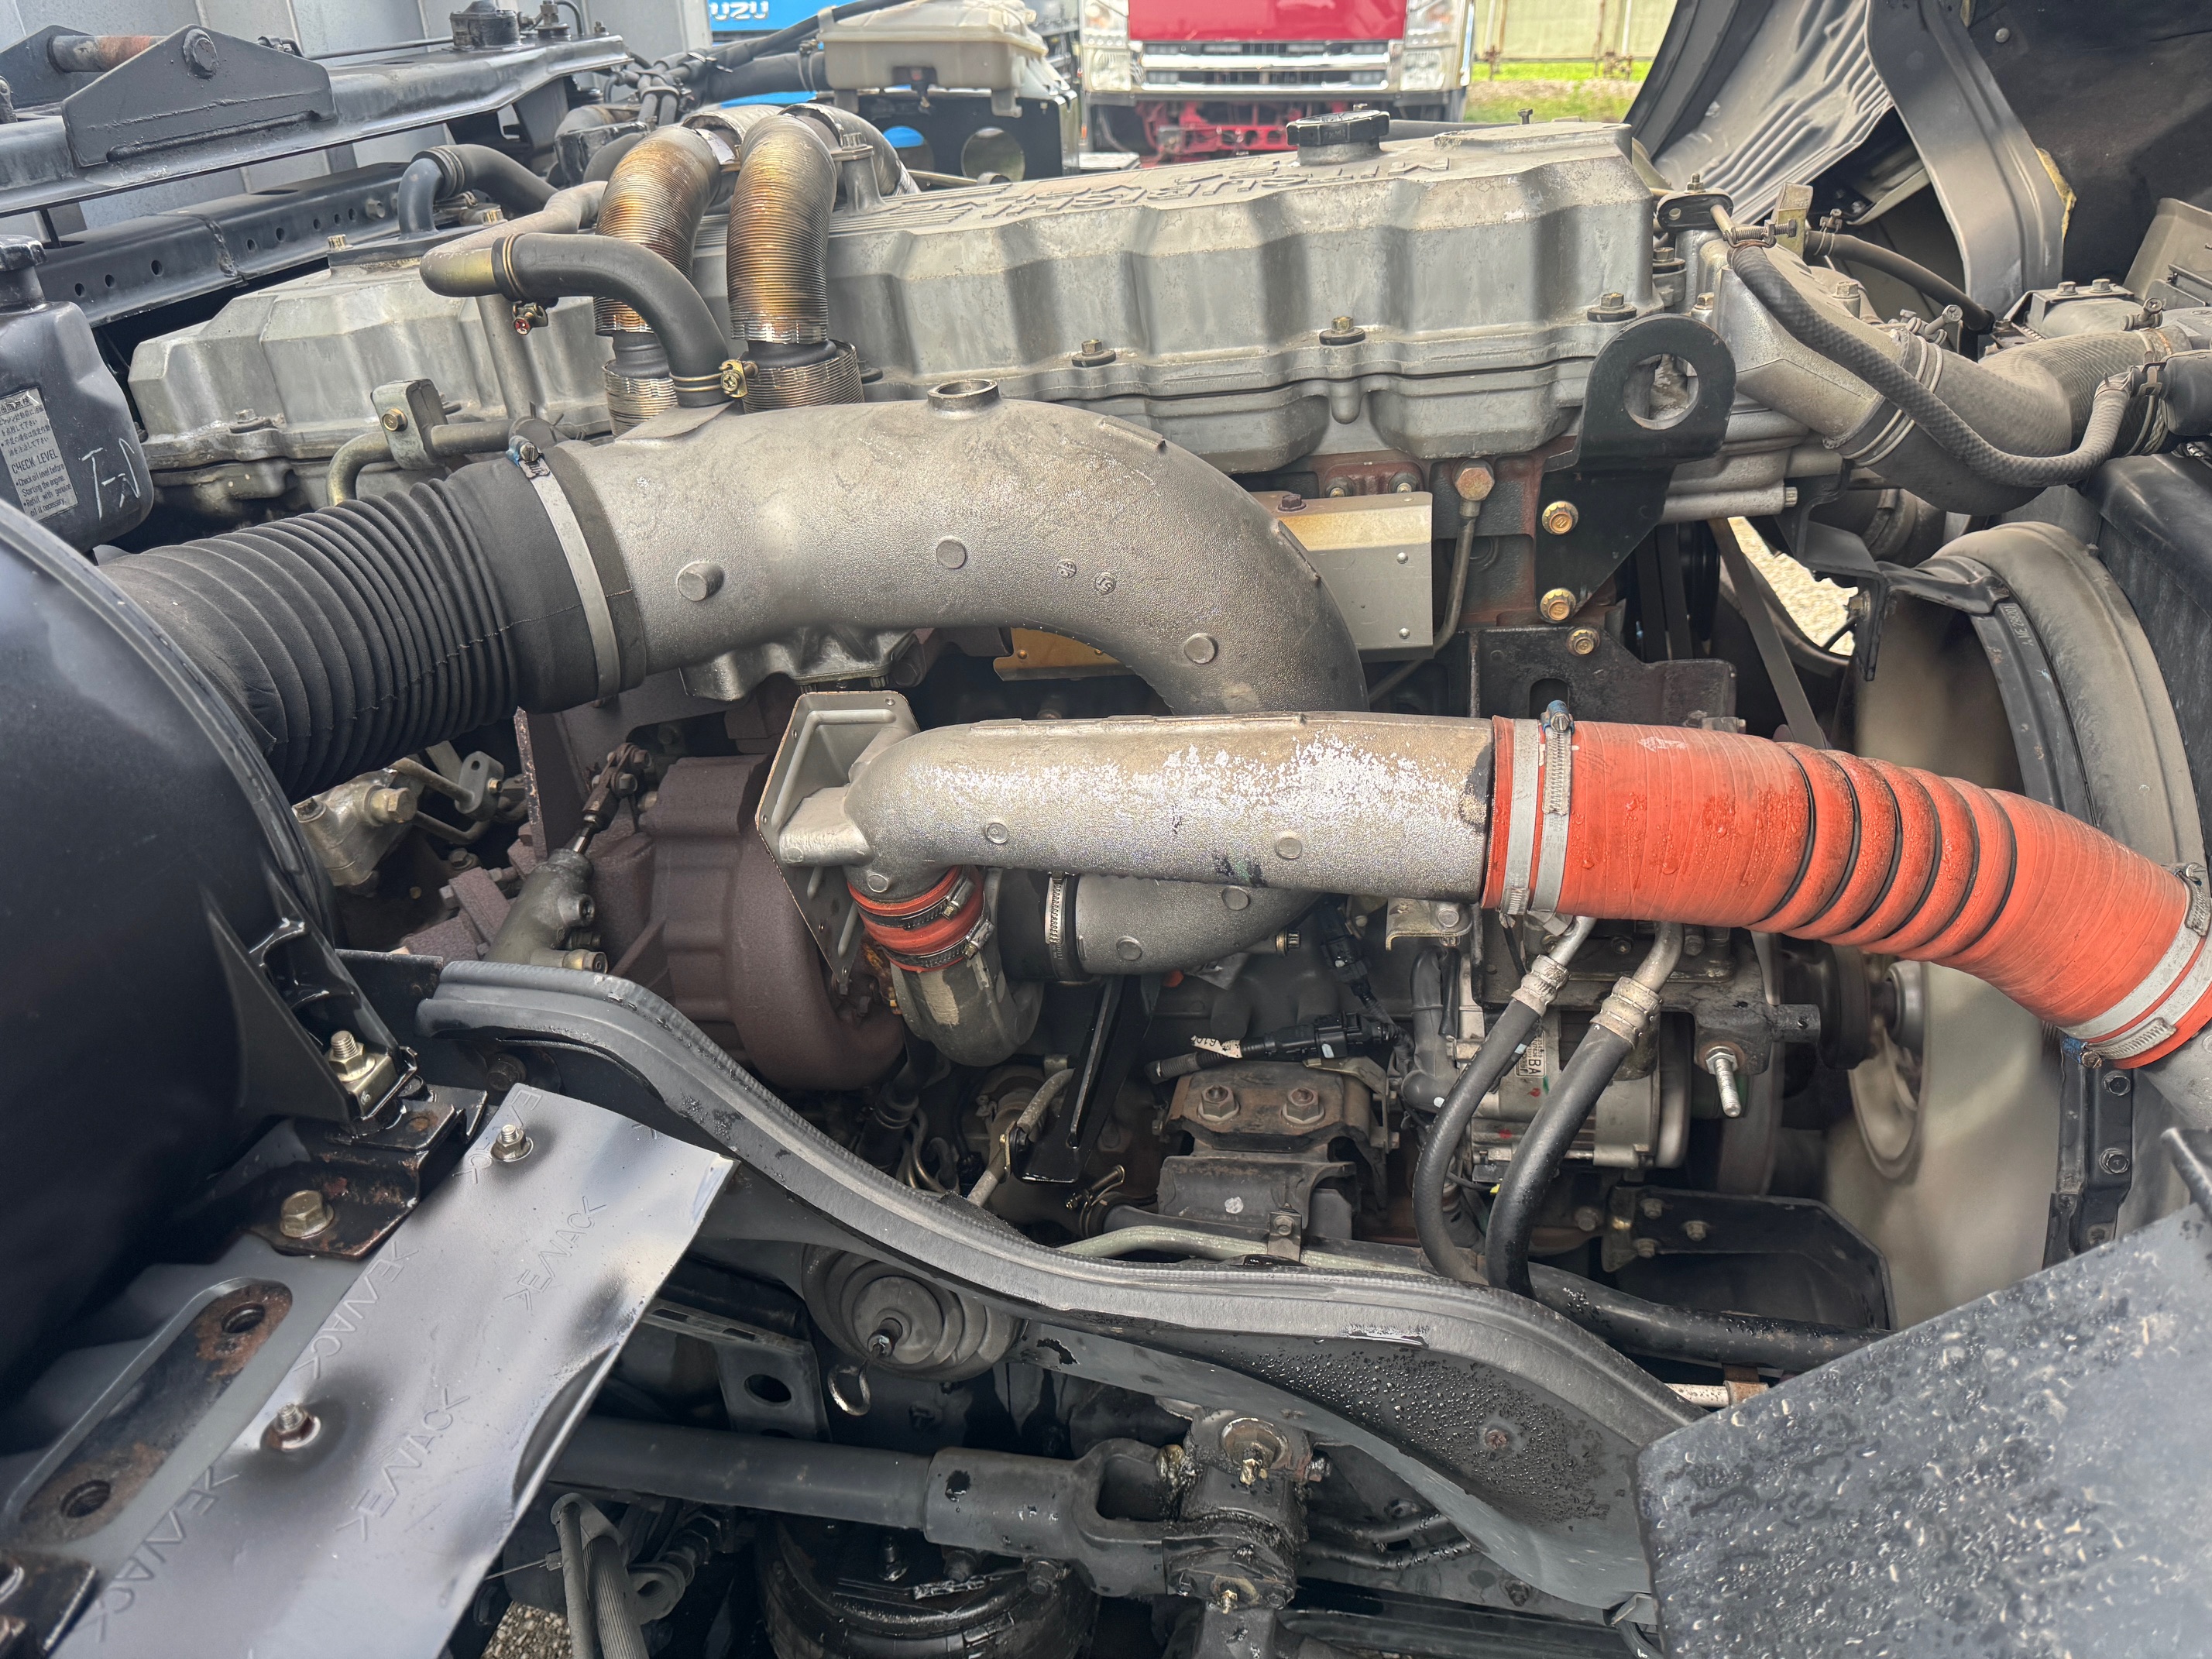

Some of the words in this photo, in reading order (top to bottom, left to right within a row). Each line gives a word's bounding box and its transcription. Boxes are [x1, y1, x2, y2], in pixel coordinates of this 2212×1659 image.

[709, 1, 769, 21] UZU
[981, 157, 1450, 220] MITSUBISHI
[12, 457, 36, 474] CHECK
[36, 449, 59, 465] LEVEL
[49, 464, 65, 475] before
[22, 483, 43, 497] Starting
[42, 480, 50, 489] the
[42, 490, 53, 500] with
[1528, 1059, 1541, 1075] BA
